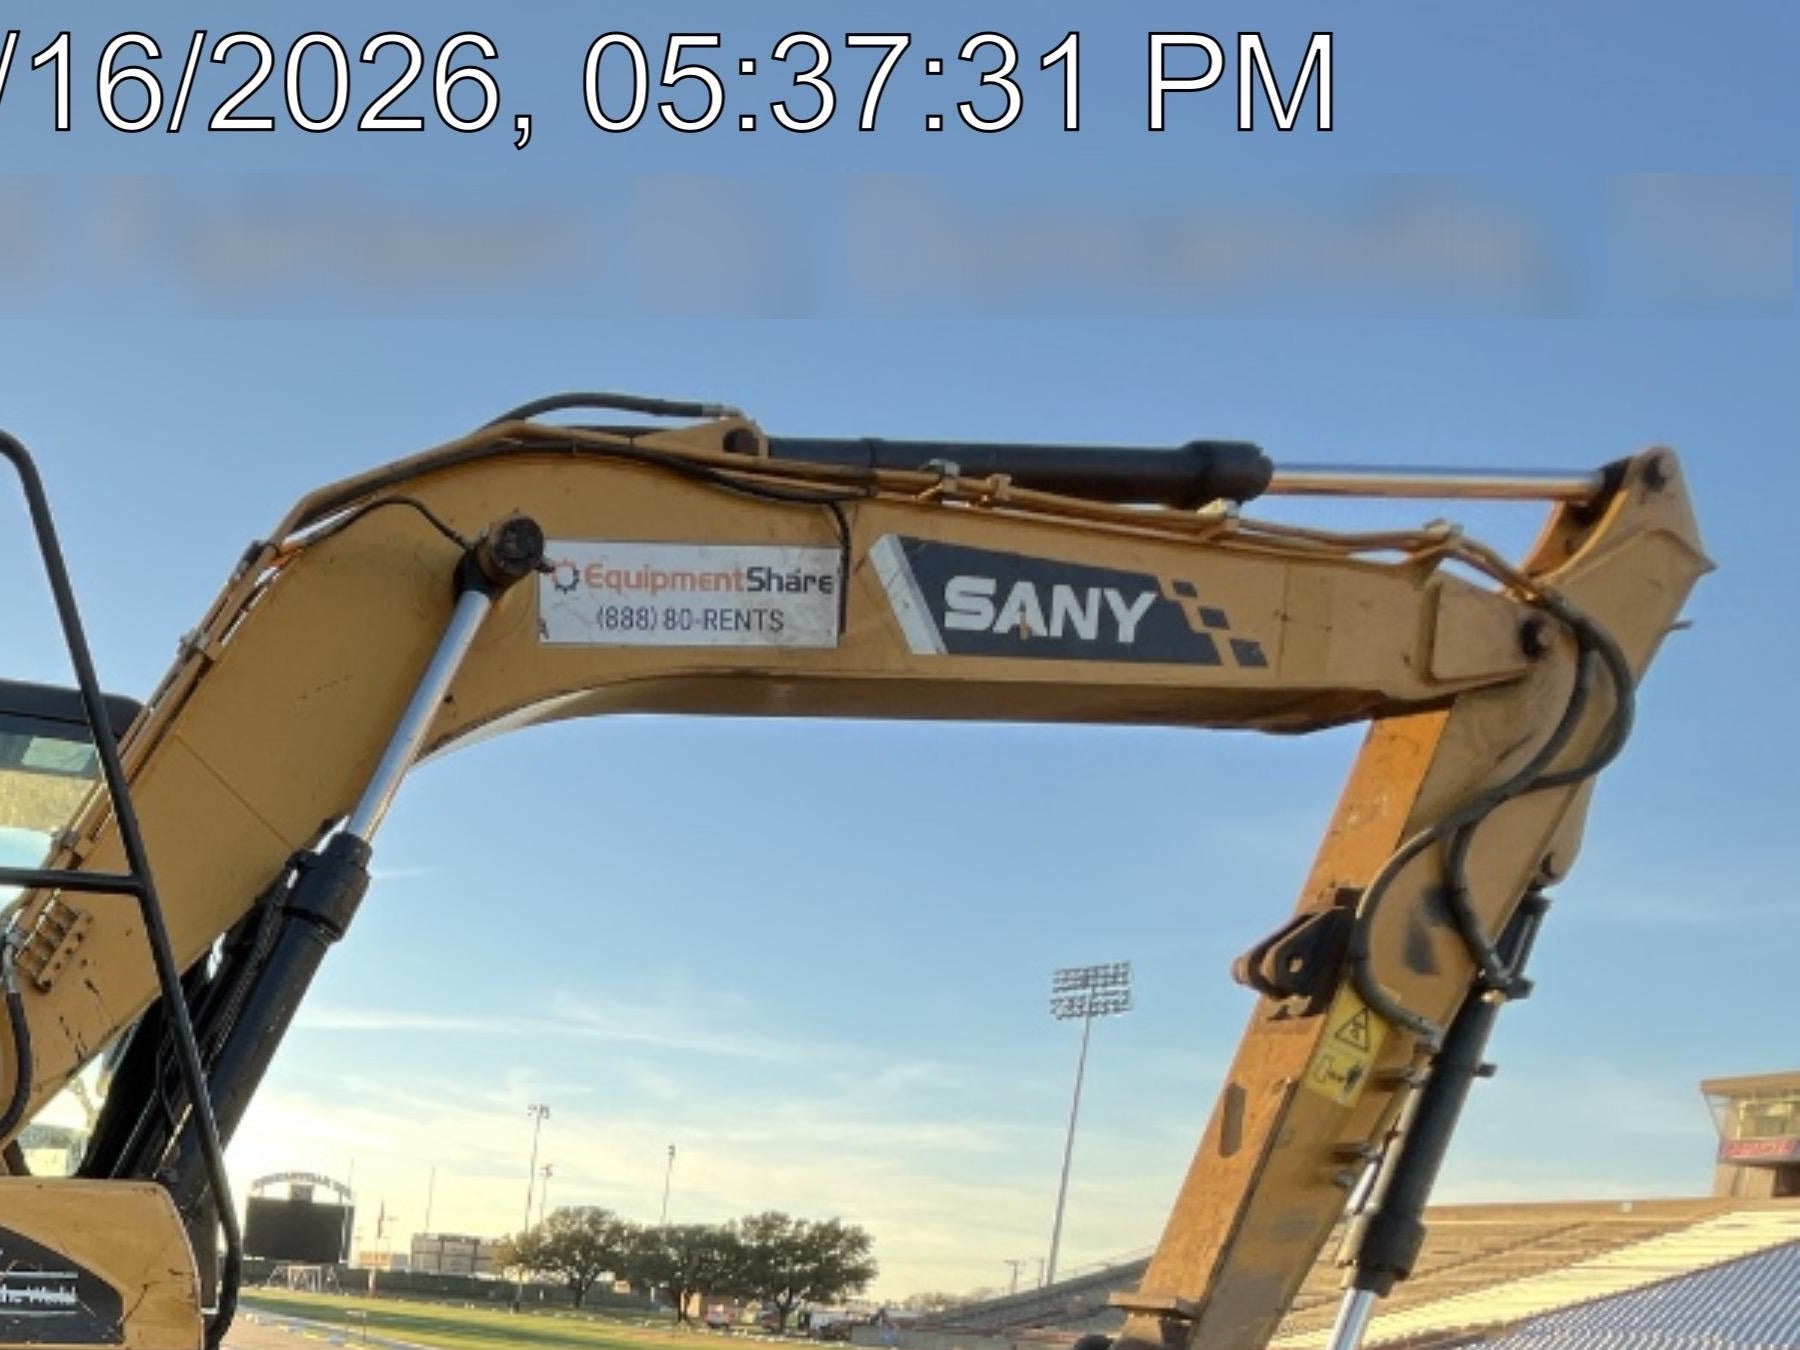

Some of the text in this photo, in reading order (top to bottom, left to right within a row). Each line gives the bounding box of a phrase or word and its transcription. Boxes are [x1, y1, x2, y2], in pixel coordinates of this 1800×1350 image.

[584, 563, 834, 597] EquipmentShare
[597, 605, 784, 634] (888) 80-RENTS
[944, 574, 1159, 644] SANY
